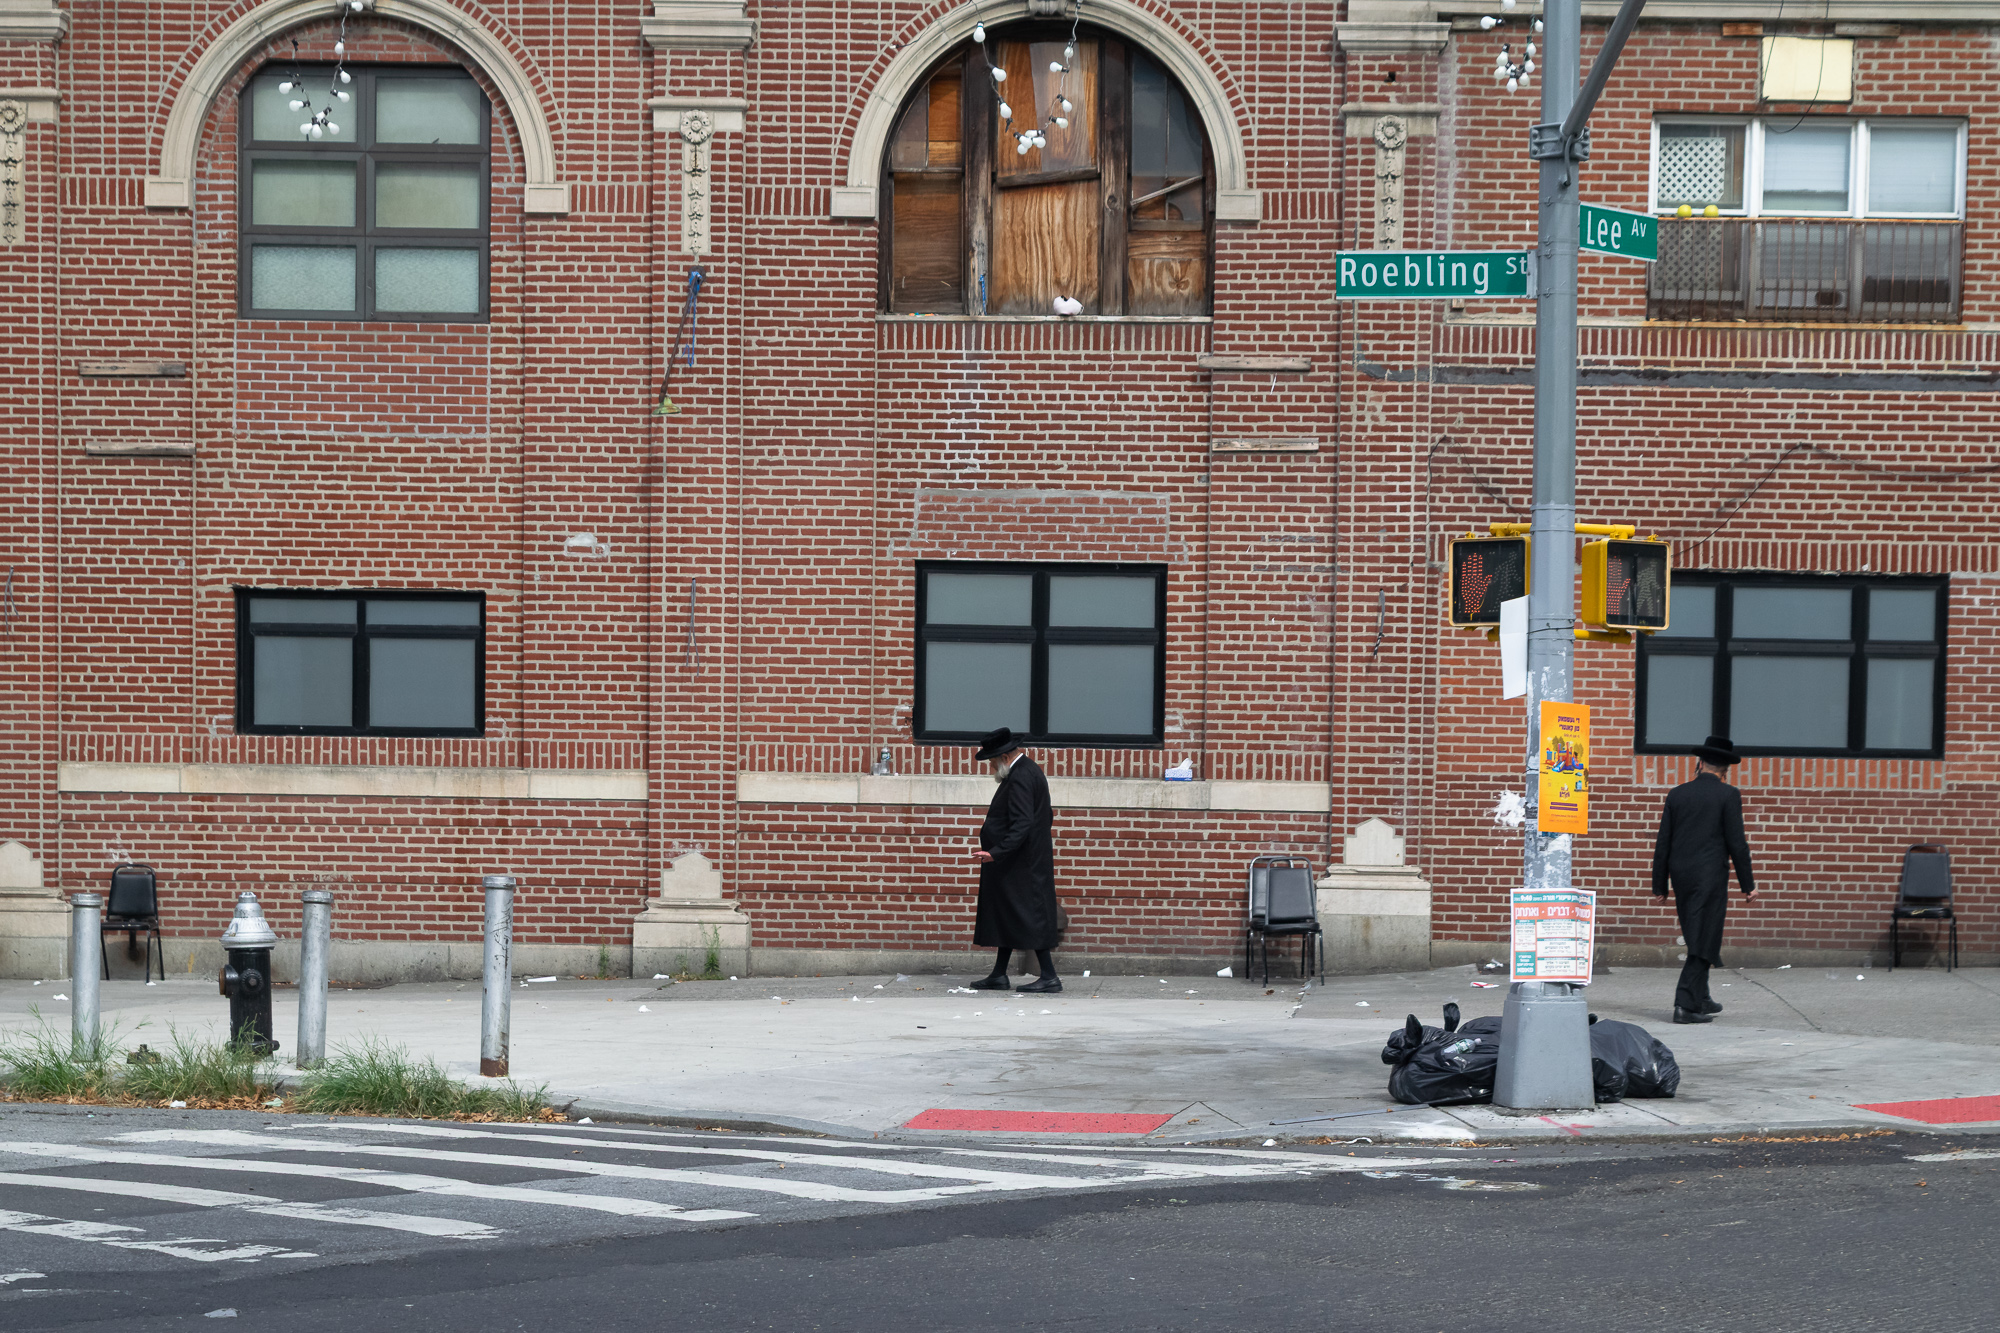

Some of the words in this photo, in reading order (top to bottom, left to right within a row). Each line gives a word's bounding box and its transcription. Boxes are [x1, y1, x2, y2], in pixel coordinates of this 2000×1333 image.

[1587, 210, 1621, 249] Lee
[1631, 218, 1647, 237] Av
[1340, 255, 1489, 294] Roebling
[1505, 256, 1527, 275] St
[1515, 907, 1539, 919] ואתחנן
[1547, 906, 1570, 916] דברים
